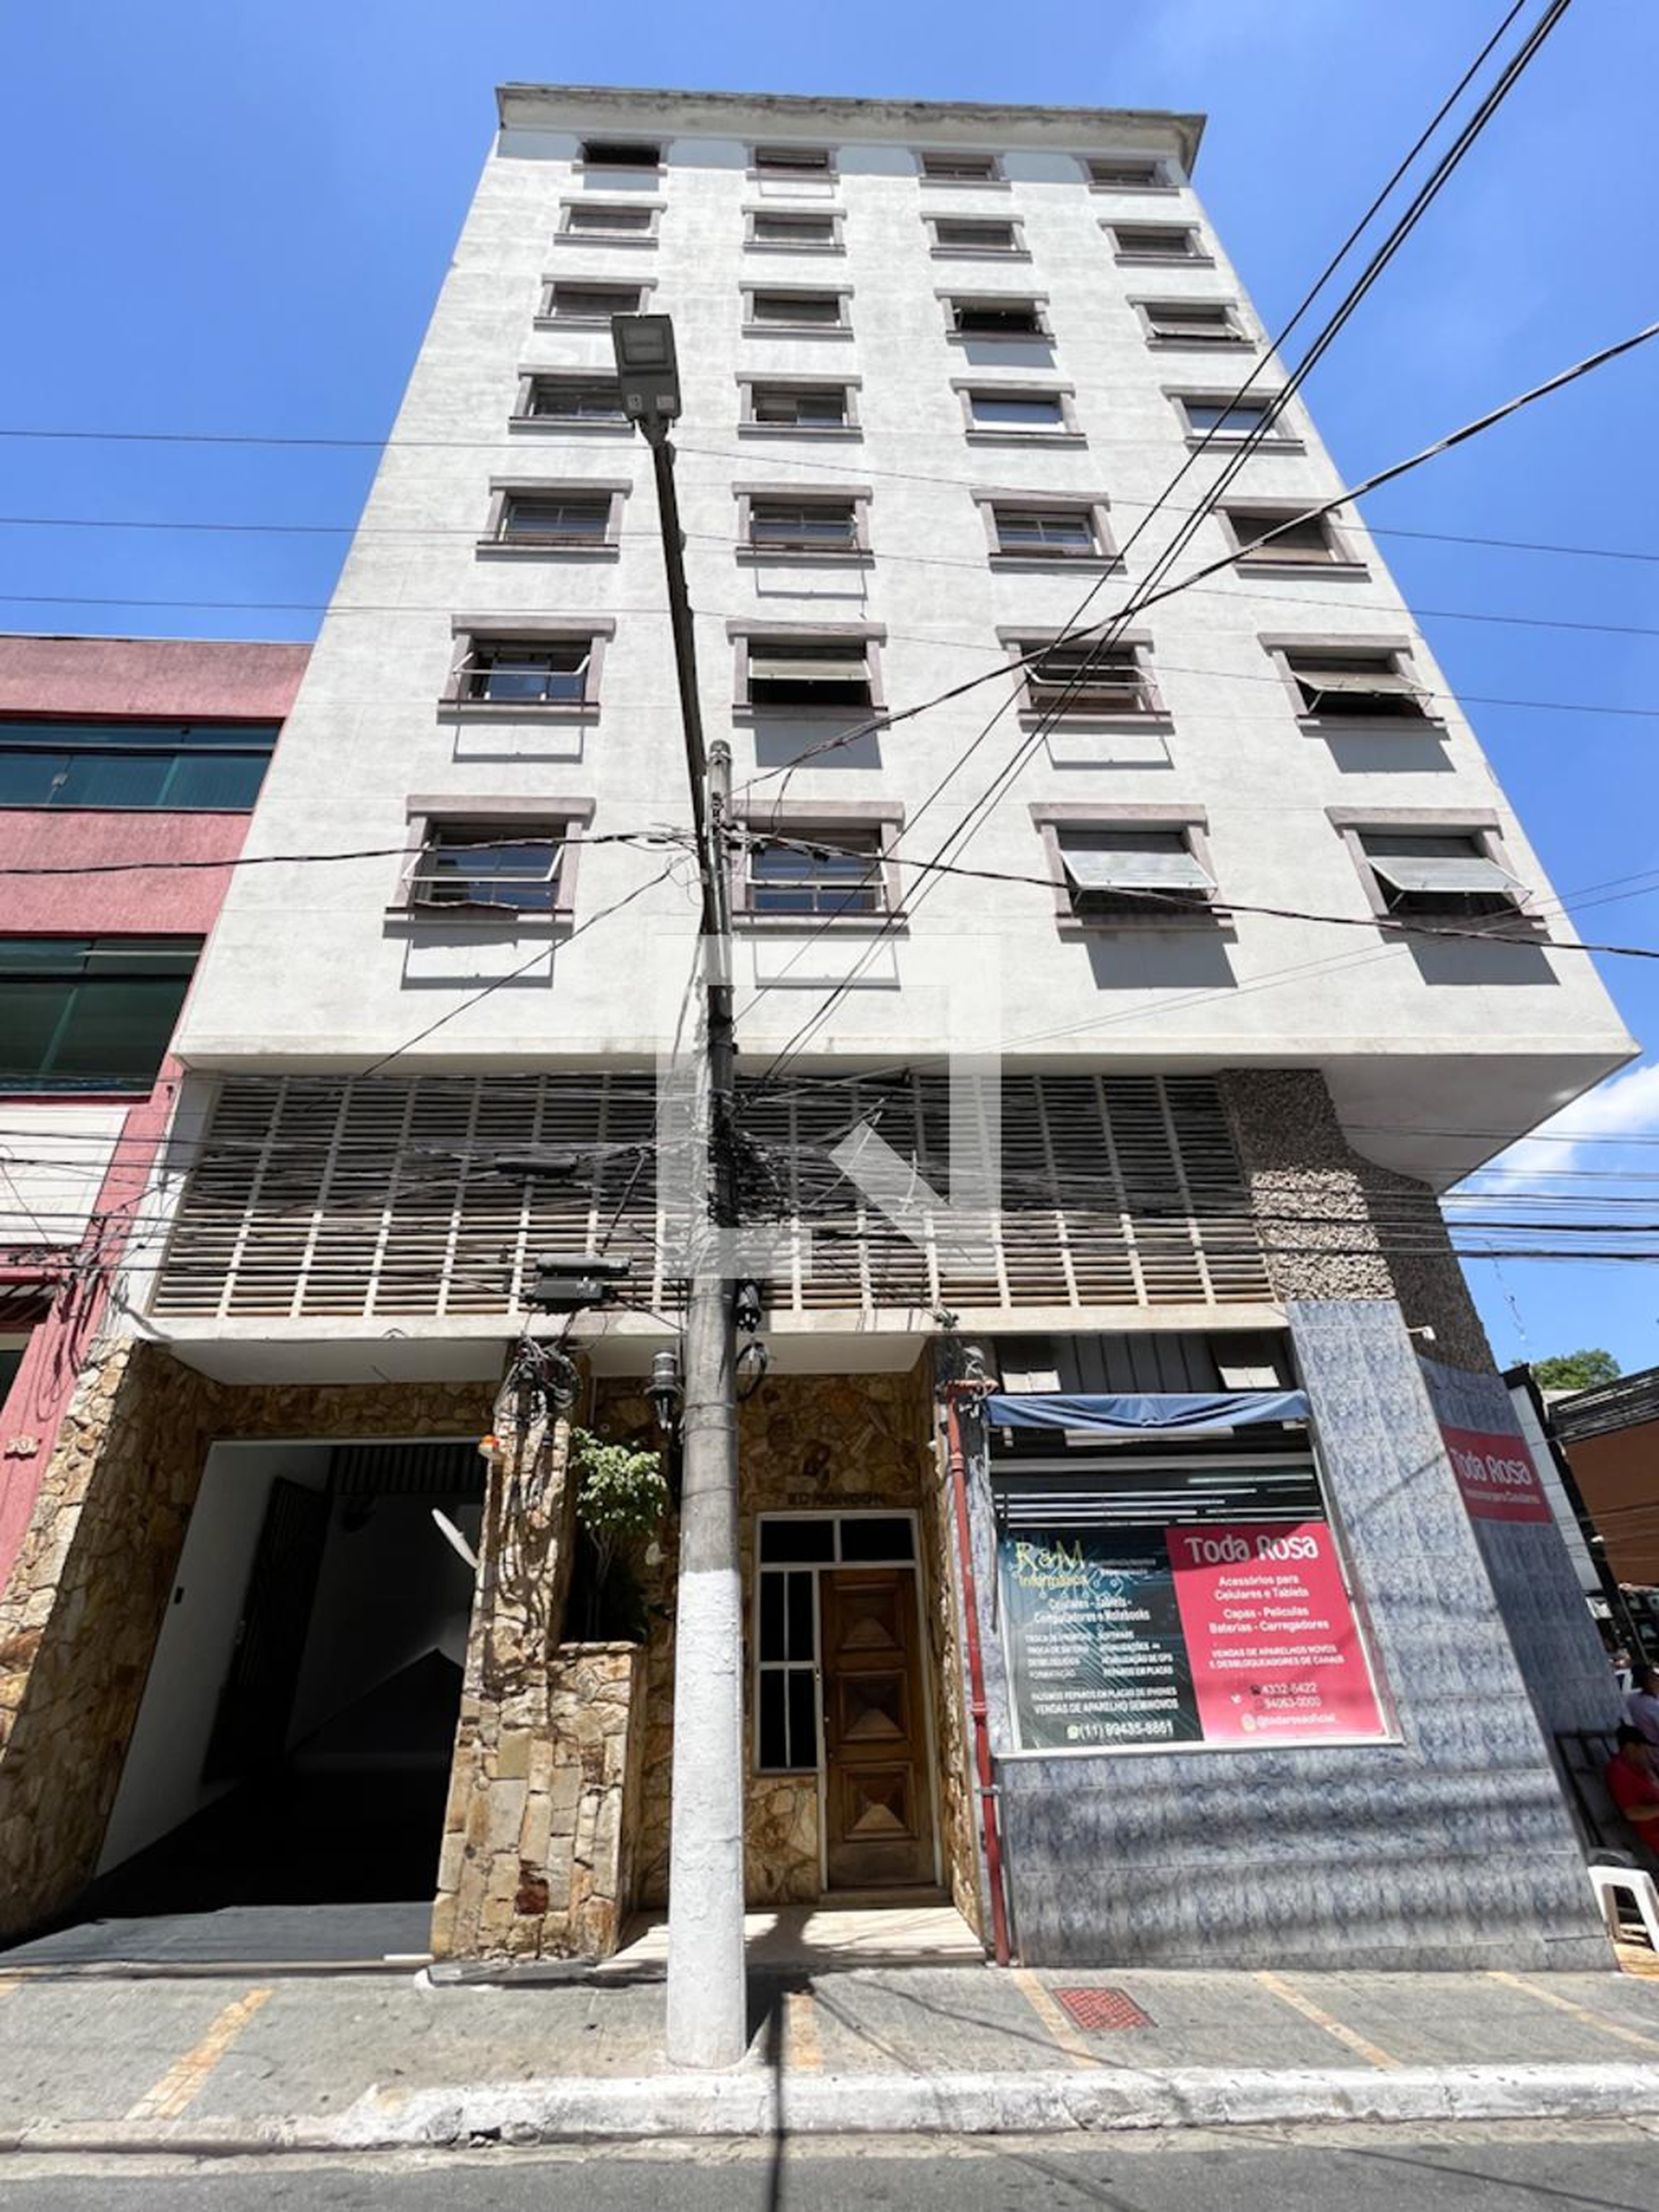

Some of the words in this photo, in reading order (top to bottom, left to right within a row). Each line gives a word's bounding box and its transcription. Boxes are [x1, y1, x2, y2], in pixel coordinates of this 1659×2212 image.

[1485, 1455, 1533, 1485] Rosa
[1184, 1534, 1250, 1564] Toda
[1256, 1535, 1319, 1561] Rosa
[1276, 1575, 1299, 1585] para
[1214, 1589, 1262, 1601] Celulares
[1273, 1587, 1309, 1598] Tablets
[1223, 1608, 1256, 1621] Capas
[1209, 1622, 1252, 1634] Baterias
[1259, 1620, 1330, 1634] Carregadores
